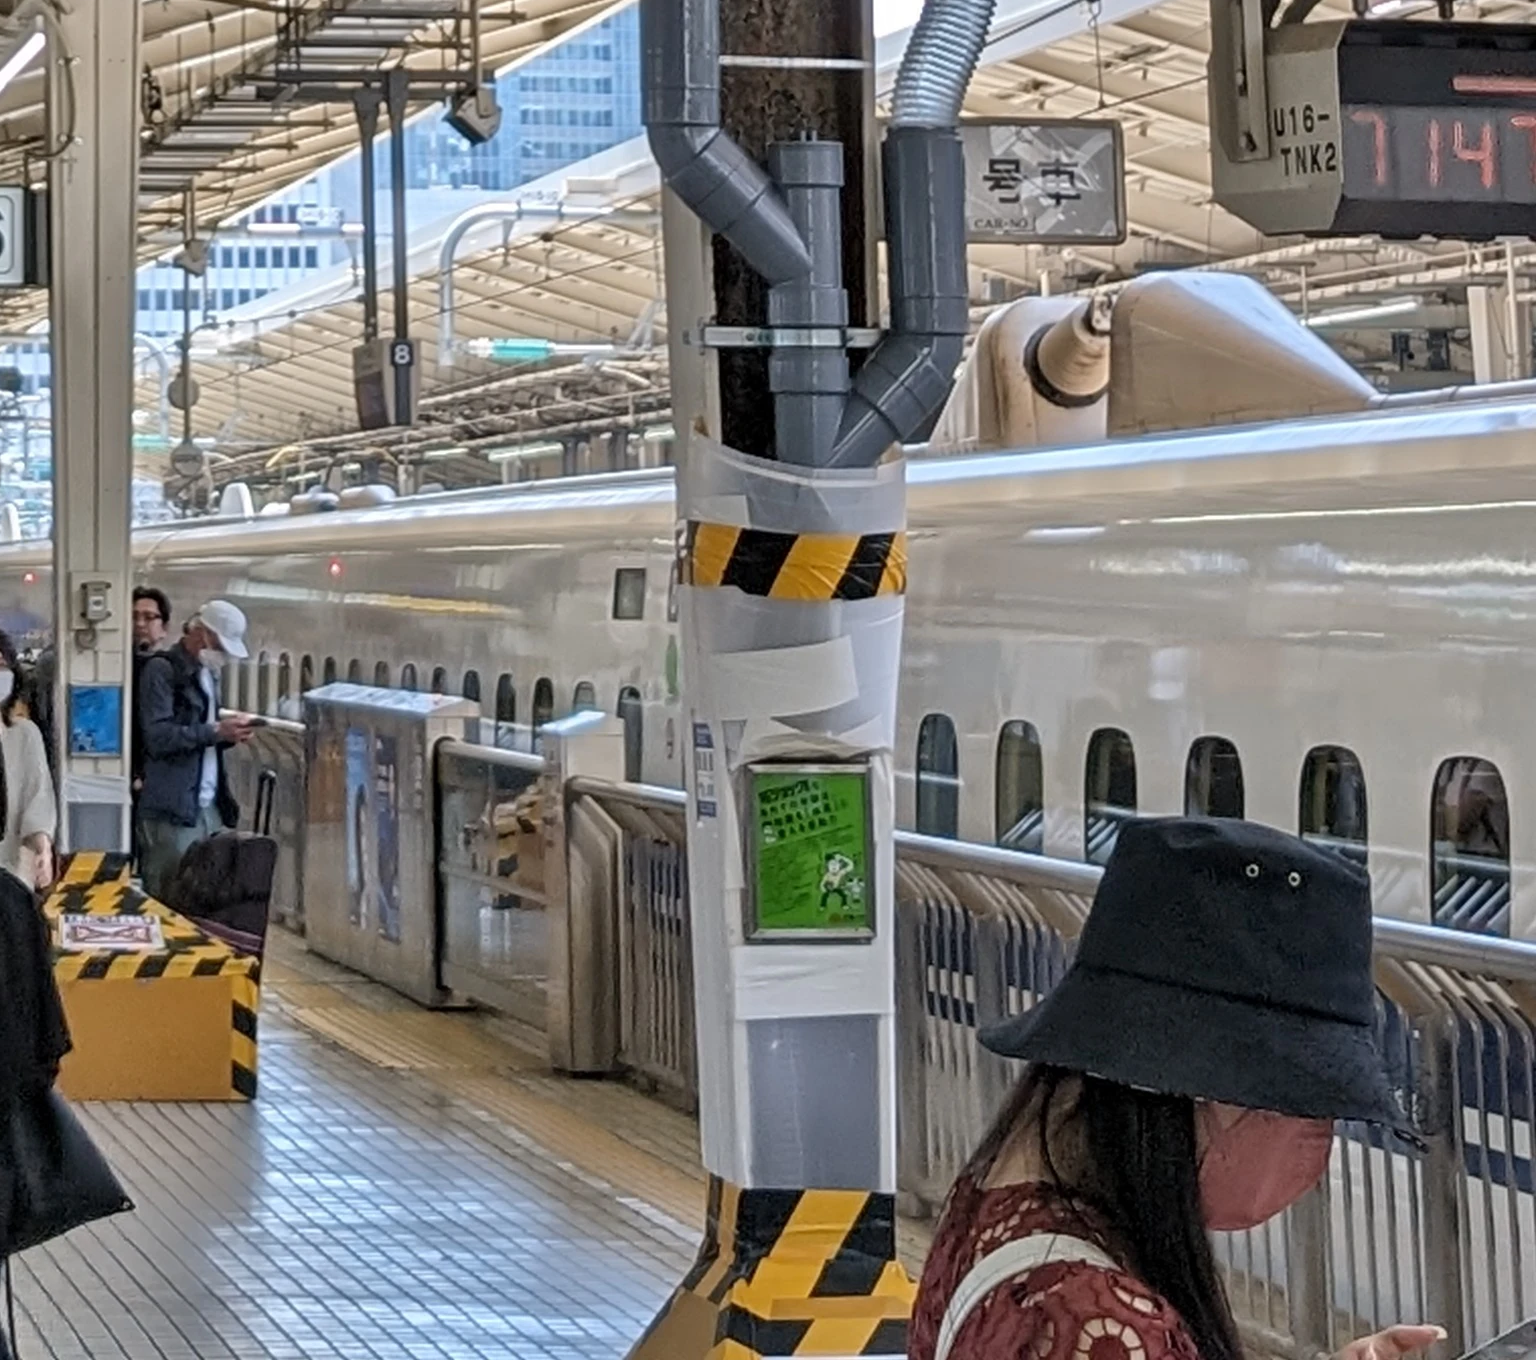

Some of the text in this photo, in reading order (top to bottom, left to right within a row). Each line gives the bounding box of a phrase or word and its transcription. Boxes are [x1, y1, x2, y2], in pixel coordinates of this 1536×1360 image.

[1274, 105, 1330, 137] U16-
[1280, 142, 1337, 176] TNK2
[394, 344, 411, 365] 8
